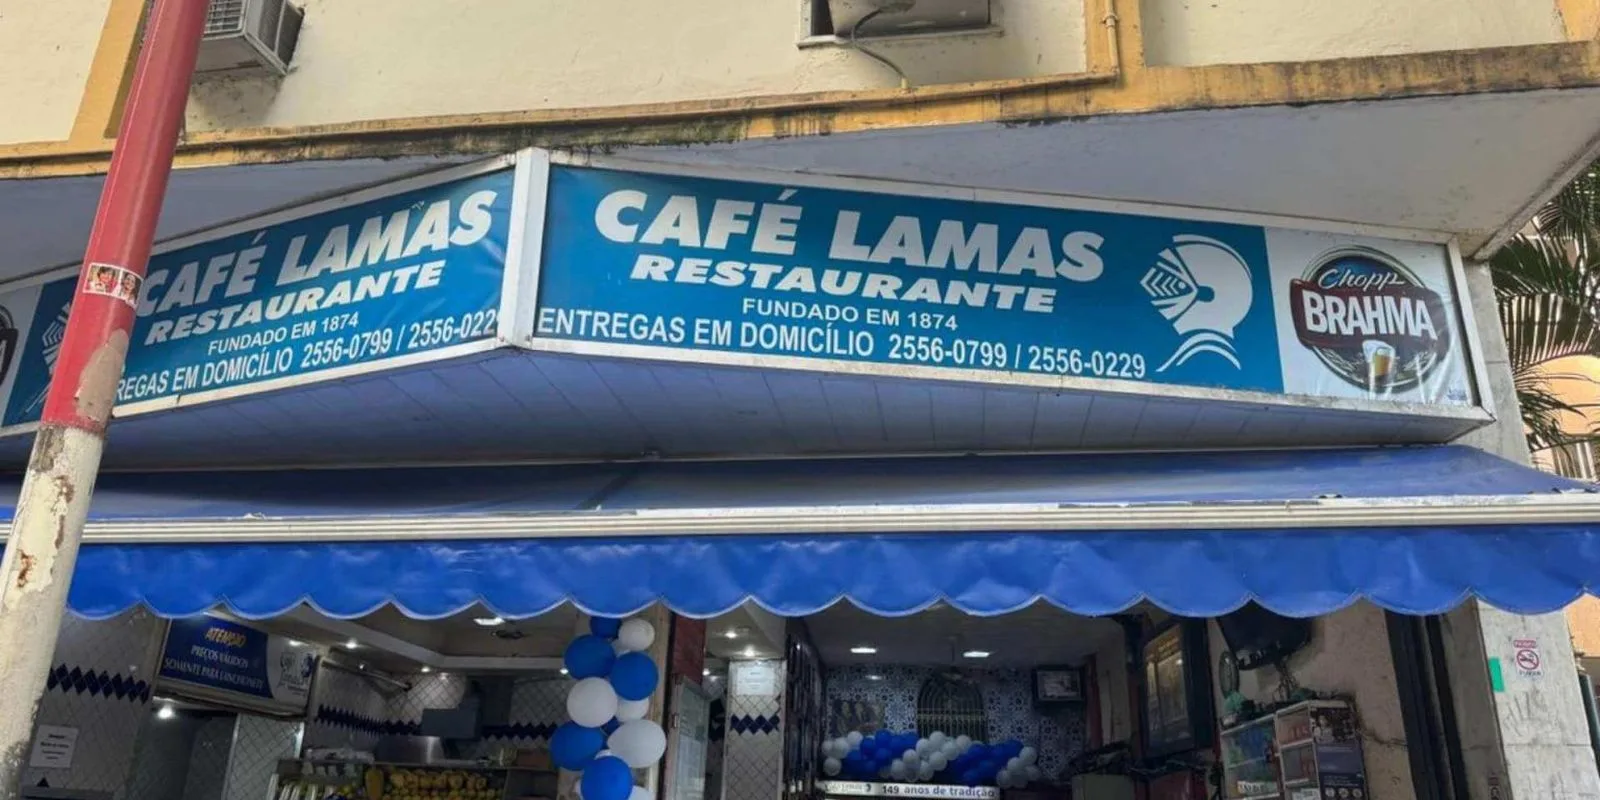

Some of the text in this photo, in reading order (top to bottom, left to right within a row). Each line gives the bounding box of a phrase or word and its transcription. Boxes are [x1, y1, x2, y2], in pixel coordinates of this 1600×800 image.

[137, 190, 498, 317] CAFÉ LAMAS
[595, 189, 1104, 282] CAFÉ LAMAS
[144, 260, 446, 346] RESTAURANTE
[630, 254, 1057, 313] RESTAURANTE
[1318, 267, 1405, 293] Chopp
[207, 311, 360, 356] FUNDADO EM 1874
[537, 307, 1146, 379] ENTREGAS EM DOMICÍLIO 2556-0799 / 2556-0229
[743, 298, 958, 331] FUNDADO EM 1874
[1302, 288, 1439, 341] BRAHMA
[172, 364, 199, 392] EM
[201, 346, 293, 387] DOMICÍLIO
[300, 327, 393, 369] 2556-0799
[396, 324, 405, 352] /
[903, 786, 930, 795] anos
[933, 785, 947, 796] de
